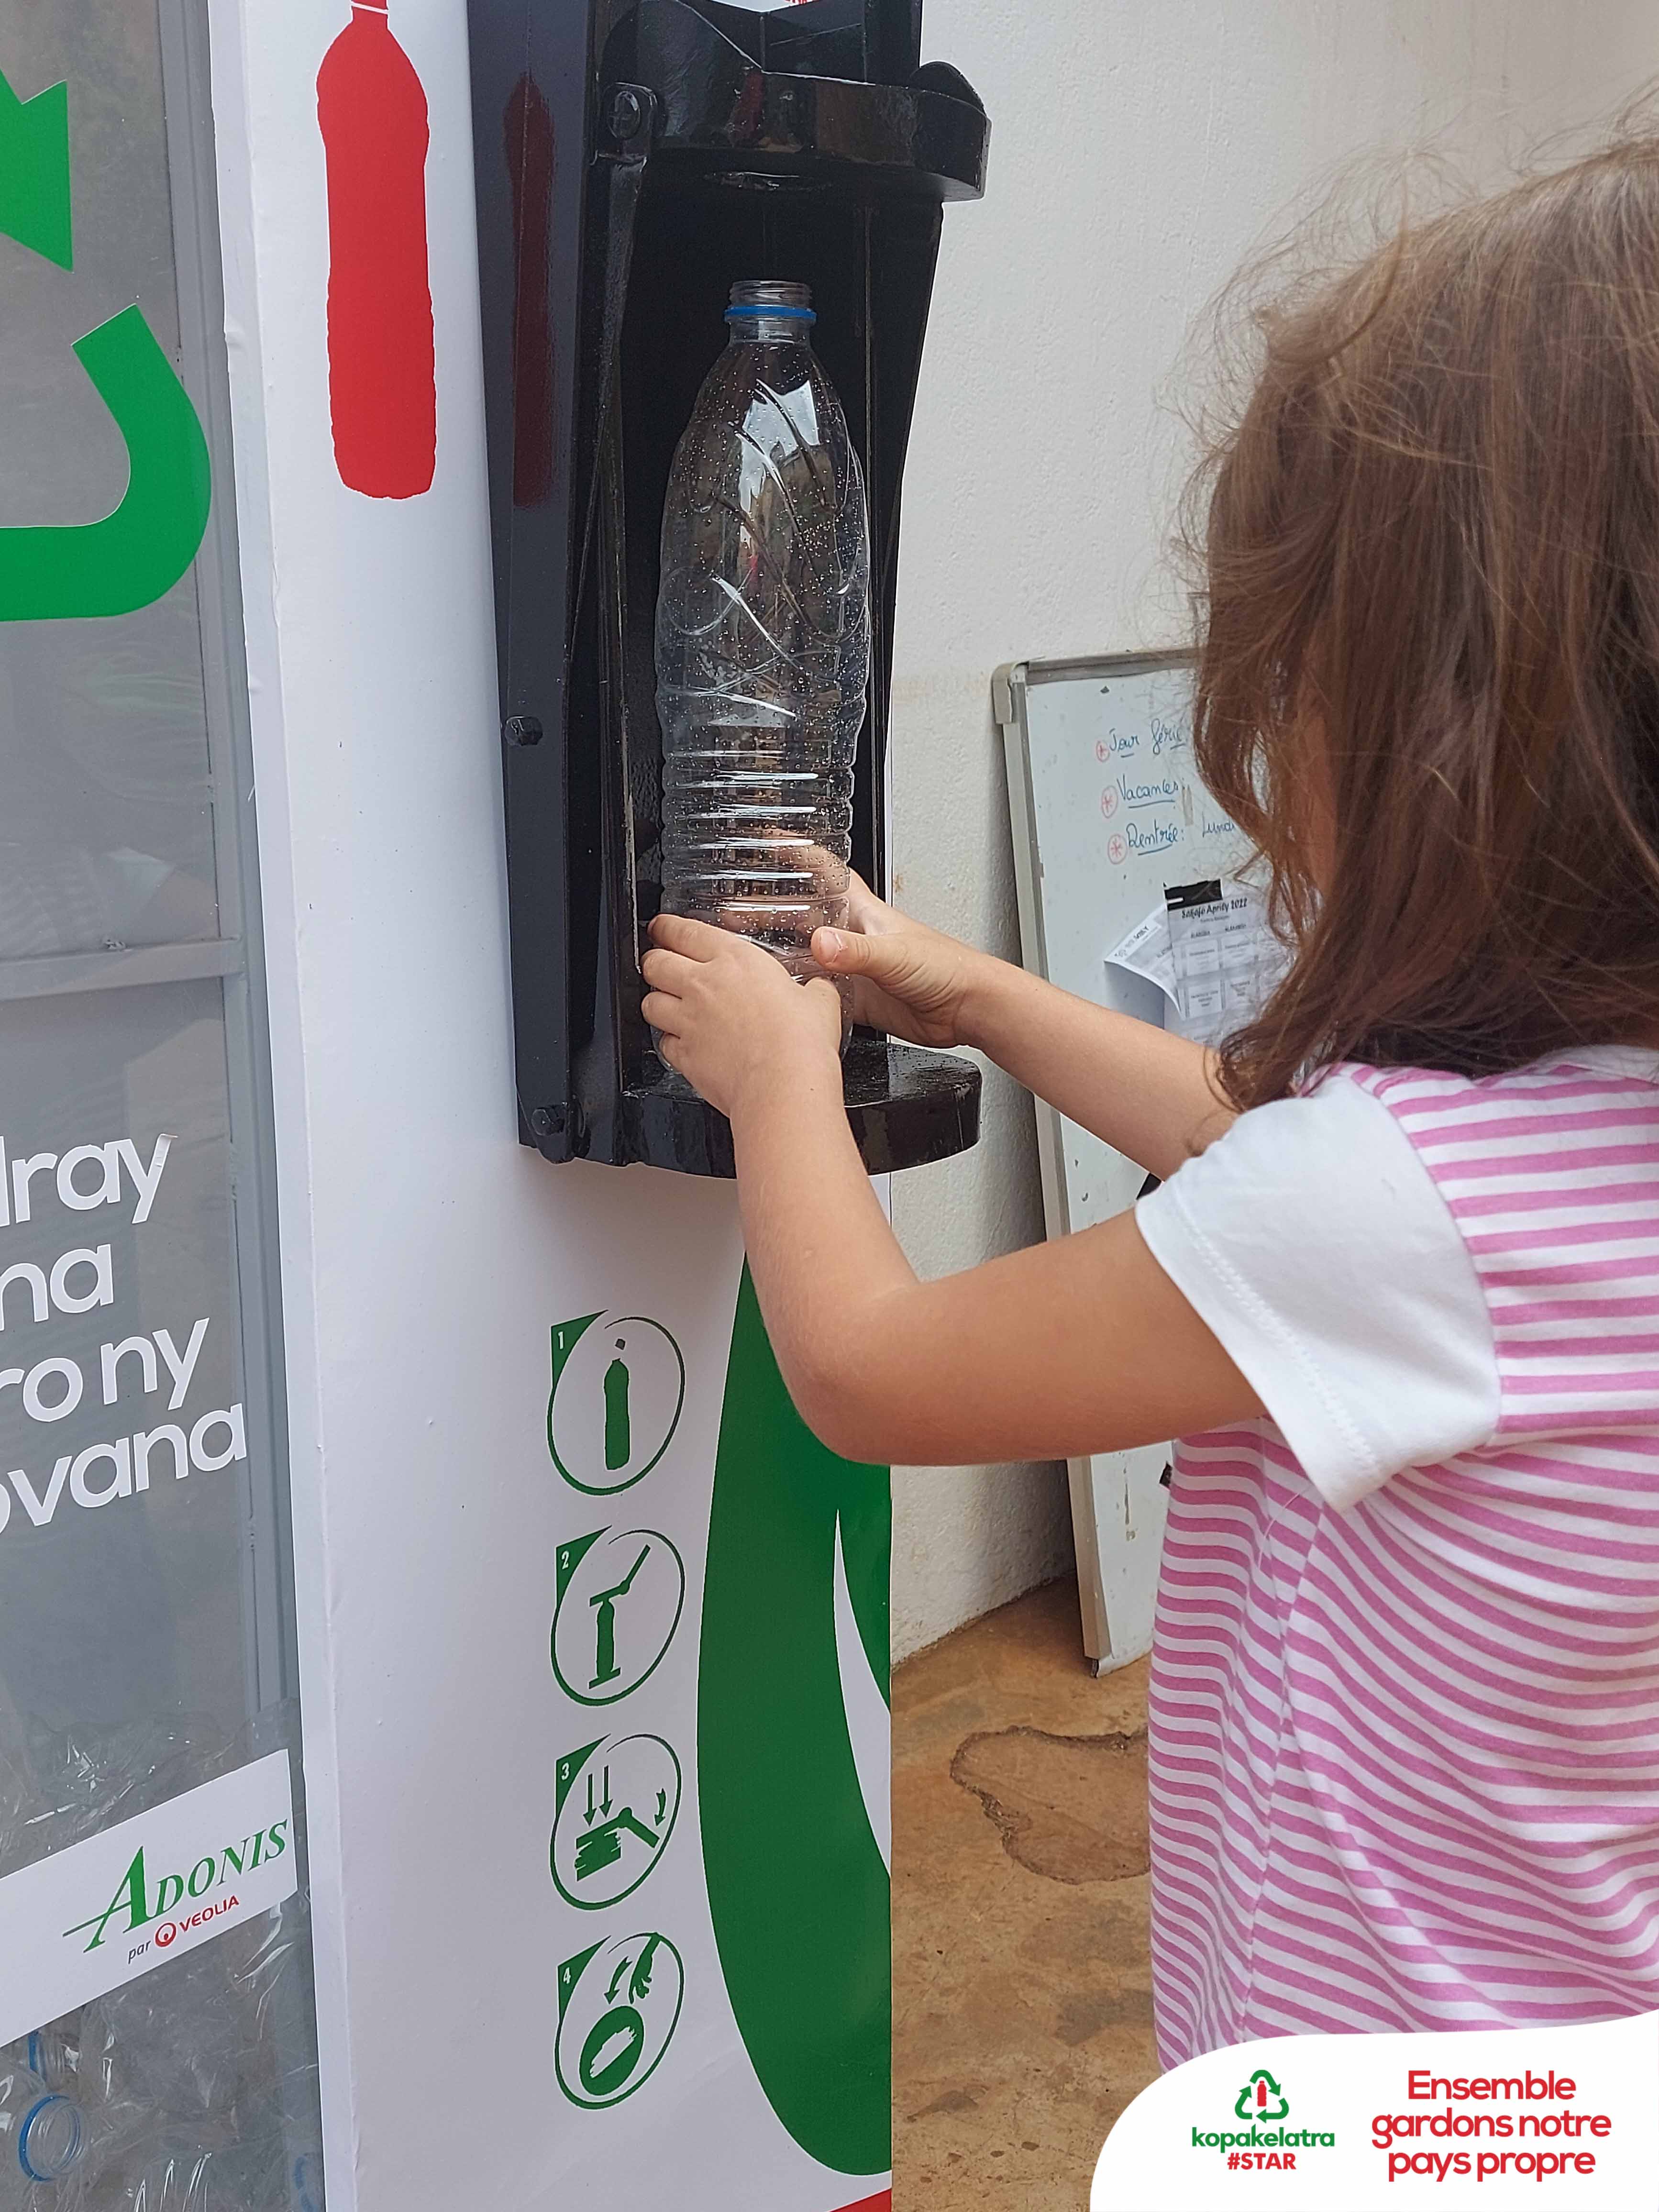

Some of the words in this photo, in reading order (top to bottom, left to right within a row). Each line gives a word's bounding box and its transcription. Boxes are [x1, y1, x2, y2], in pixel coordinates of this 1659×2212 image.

[1109, 728, 1140, 752] Jour
[1231, 897, 1248, 910] 2022
[558, 1331, 564, 1349] 1
[100, 1317, 210, 1411] ny
[0, 1403, 247, 1534] vana
[562, 1551, 569, 1570] 2
[562, 1763, 569, 1780] 3
[127, 1940, 152, 1965] par
[179, 1895, 240, 1933] VEOLIA
[563, 1967, 571, 1984] 4
